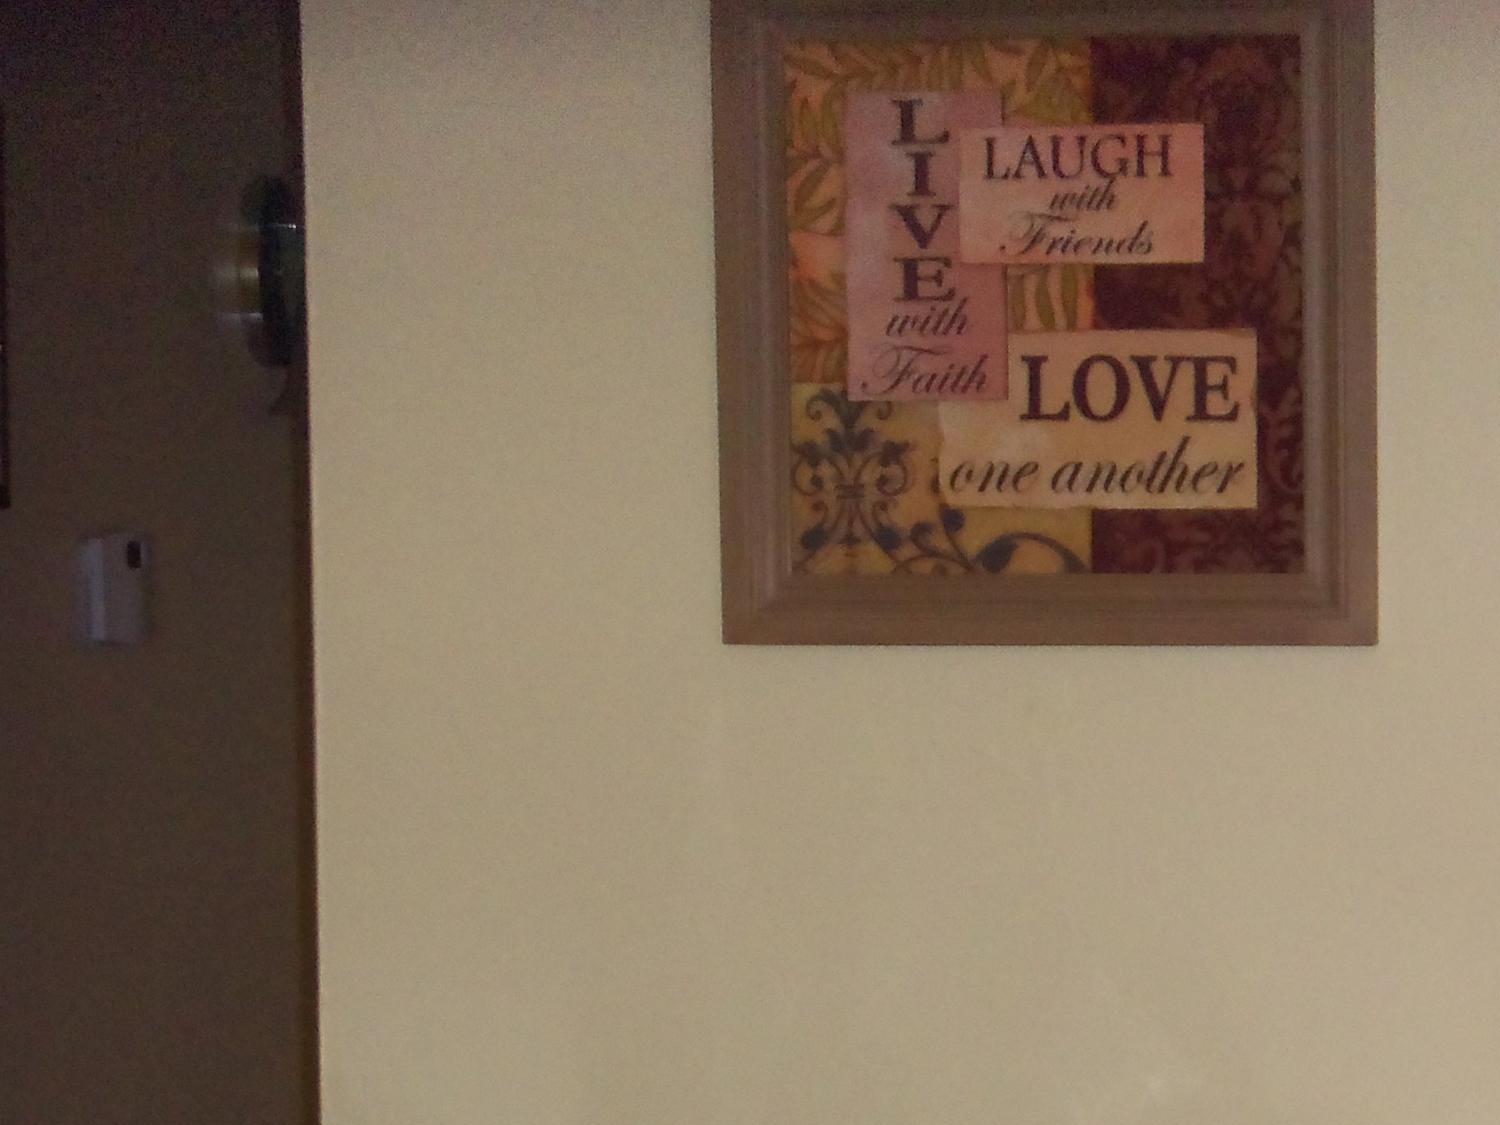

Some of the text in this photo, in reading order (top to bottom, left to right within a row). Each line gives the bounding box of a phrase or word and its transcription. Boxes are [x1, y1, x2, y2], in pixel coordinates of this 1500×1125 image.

[983, 133, 1174, 180] LAUGH
[888, 98, 956, 303] LIVE
[1049, 176, 1116, 212] with
[1000, 210, 1154, 256] Friends
[886, 297, 968, 337] with
[860, 342, 988, 396] Faith
[1019, 353, 1241, 423] LOVE
[949, 435, 1245, 494] one another
